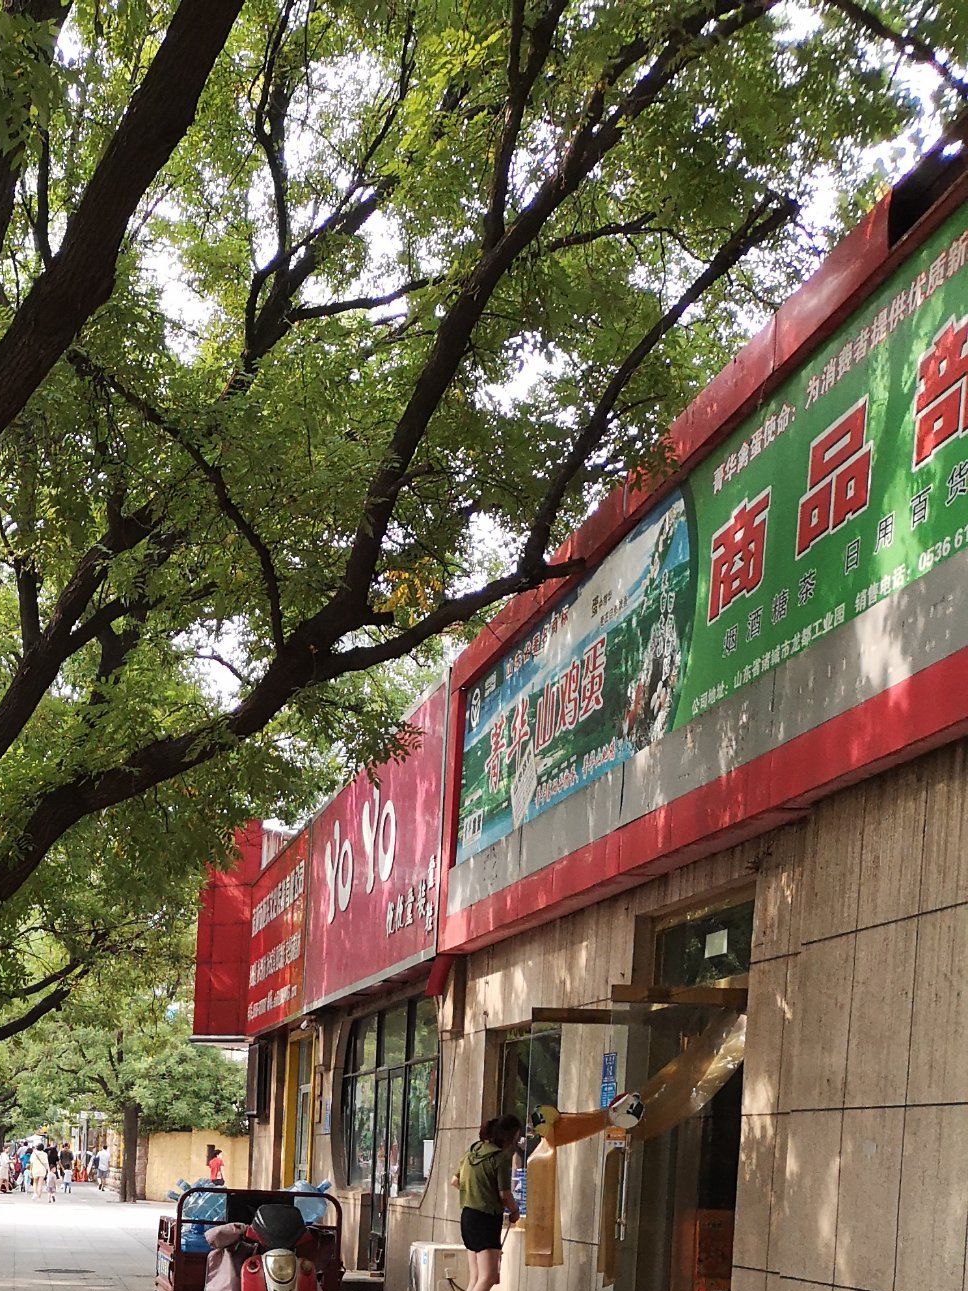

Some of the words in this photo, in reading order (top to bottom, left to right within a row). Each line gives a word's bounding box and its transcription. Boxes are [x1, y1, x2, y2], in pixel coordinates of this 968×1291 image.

[722, 569, 817, 658] 烟酒糖茶
[844, 460, 968, 575] 日用百货
[485, 632, 607, 793] 菁华山鸡蛋
